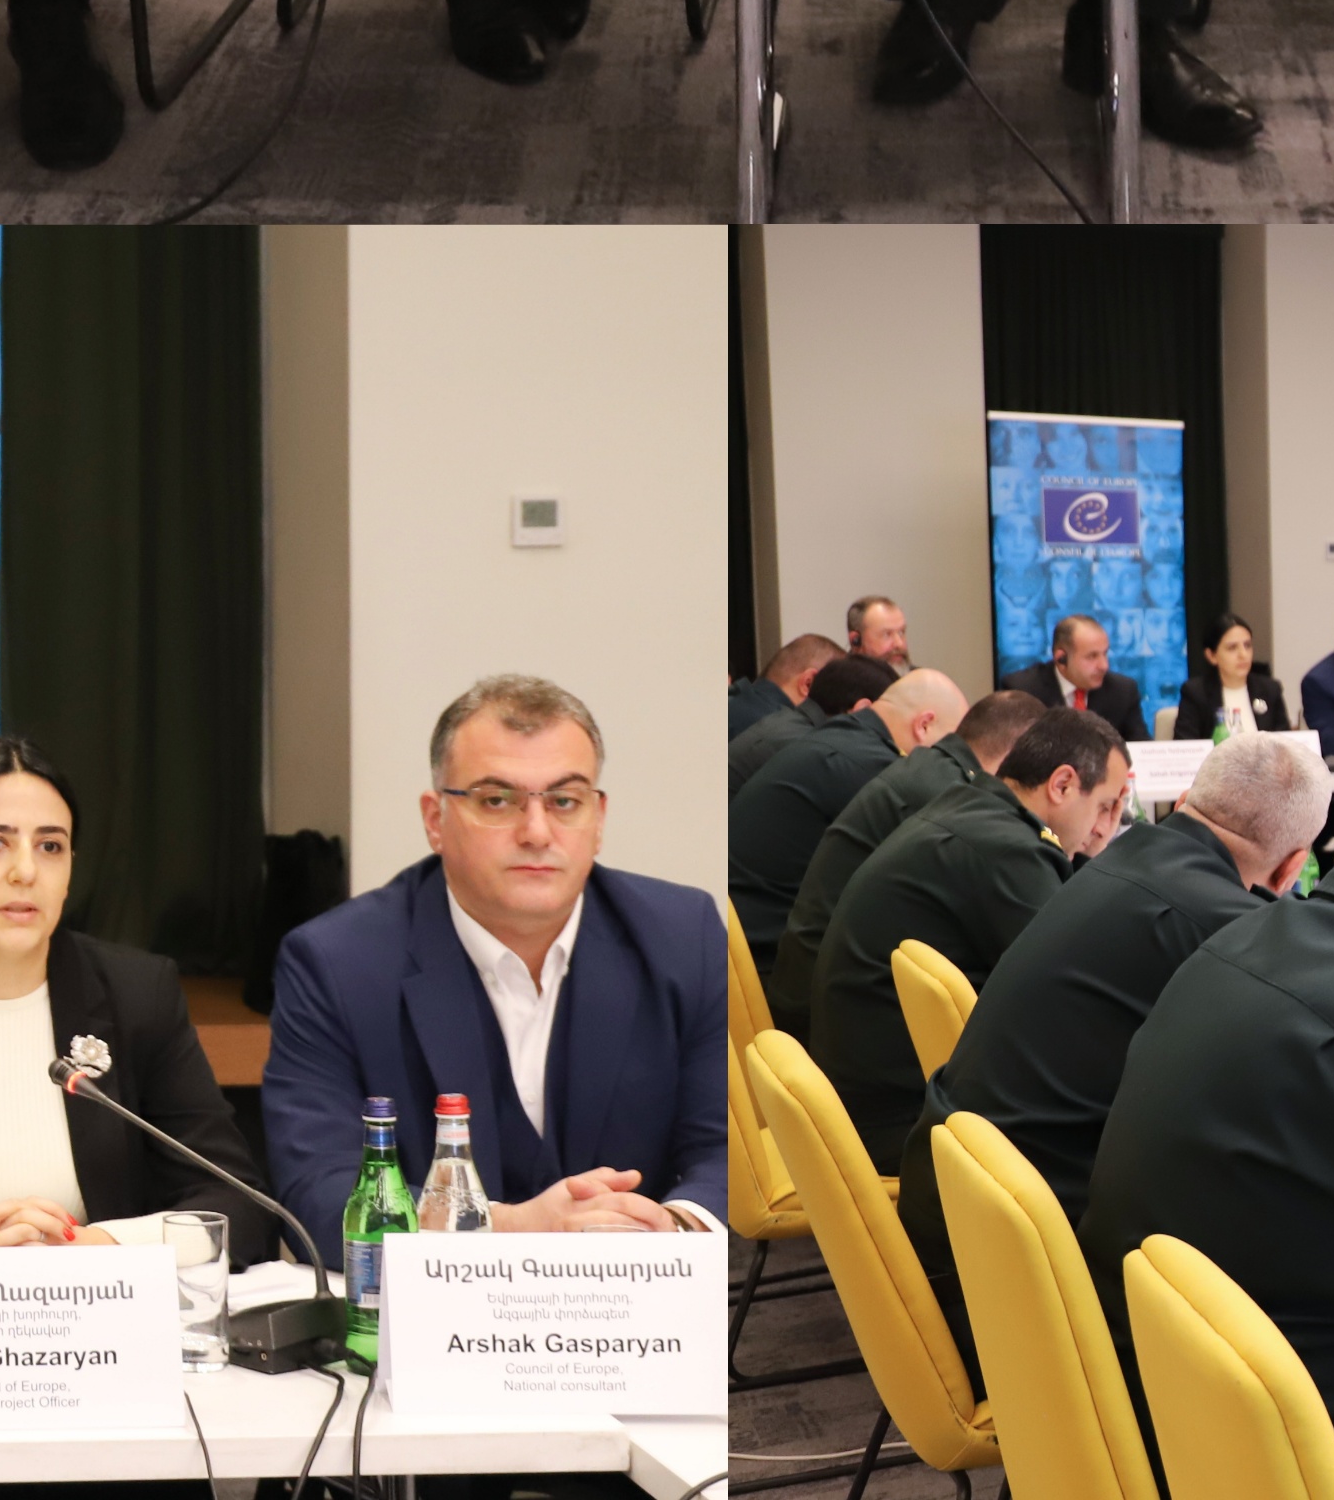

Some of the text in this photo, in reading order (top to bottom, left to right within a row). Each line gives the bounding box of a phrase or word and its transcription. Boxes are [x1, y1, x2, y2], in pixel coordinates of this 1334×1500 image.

[425, 1258, 692, 1283] Արշակ Գասպարյան
[493, 1308, 630, 1322] Ազգային փորձագետ
[7, 1325, 70, 1339] ղեկավար
[447, 1333, 682, 1358] Arshak Gasparyan
[505, 1363, 624, 1377] Council of Europe,
[4, 1381, 18, 1393] of
[21, 1380, 71, 1395] Europe,
[503, 1379, 627, 1392] National consultant
[38, 1396, 81, 1409] Officer
